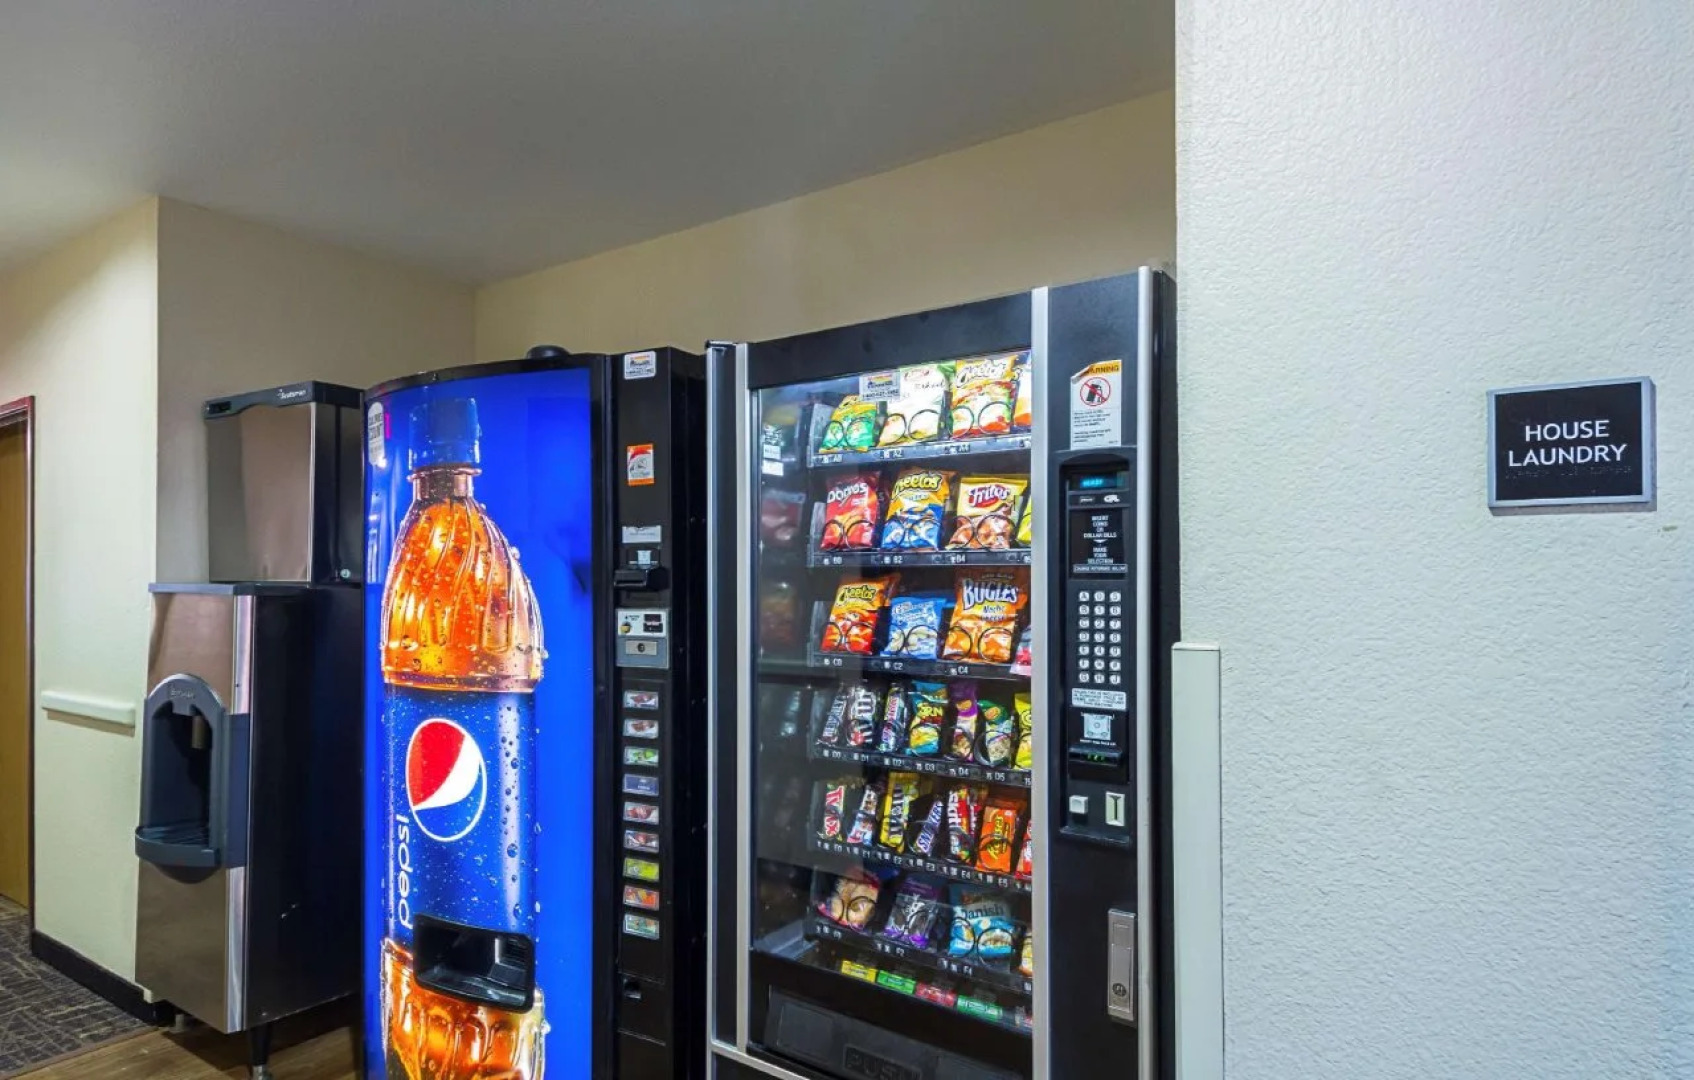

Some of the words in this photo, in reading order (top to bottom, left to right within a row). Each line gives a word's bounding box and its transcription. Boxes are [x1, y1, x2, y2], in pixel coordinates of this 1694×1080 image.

[1525, 420, 1609, 442] HOUSE
[1508, 443, 1627, 467] LAUNDRY
[396, 814, 413, 930] pepsi
